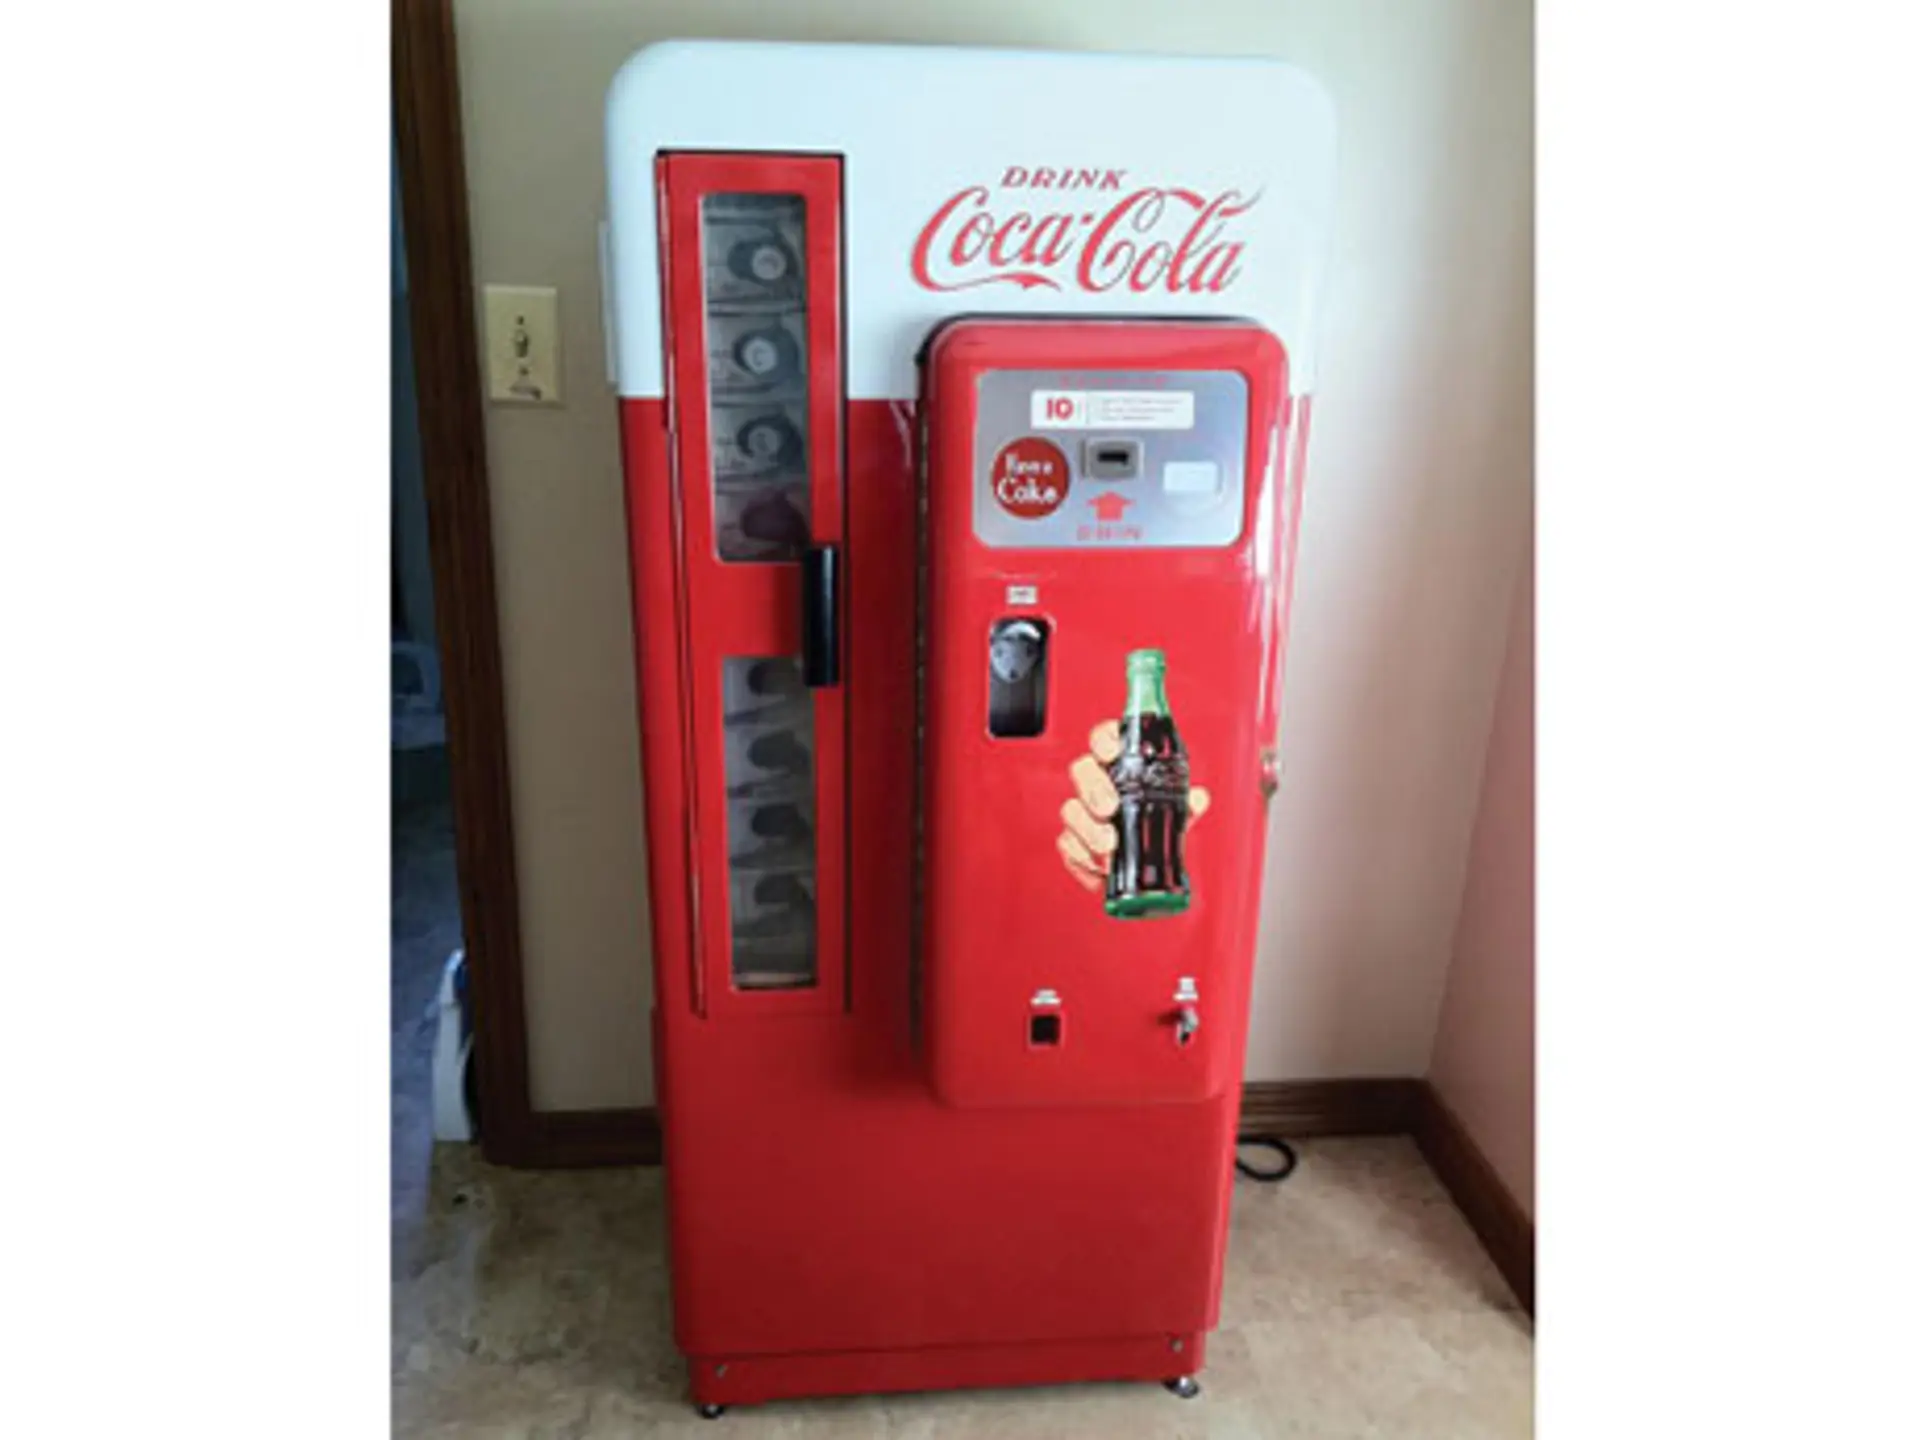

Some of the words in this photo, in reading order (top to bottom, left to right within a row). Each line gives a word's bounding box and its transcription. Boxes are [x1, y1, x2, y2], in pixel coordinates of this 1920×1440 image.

[1001, 165, 1126, 190] DRINK
[910, 185, 1264, 293] Coca-Cola
[1046, 397, 1074, 420] 10
